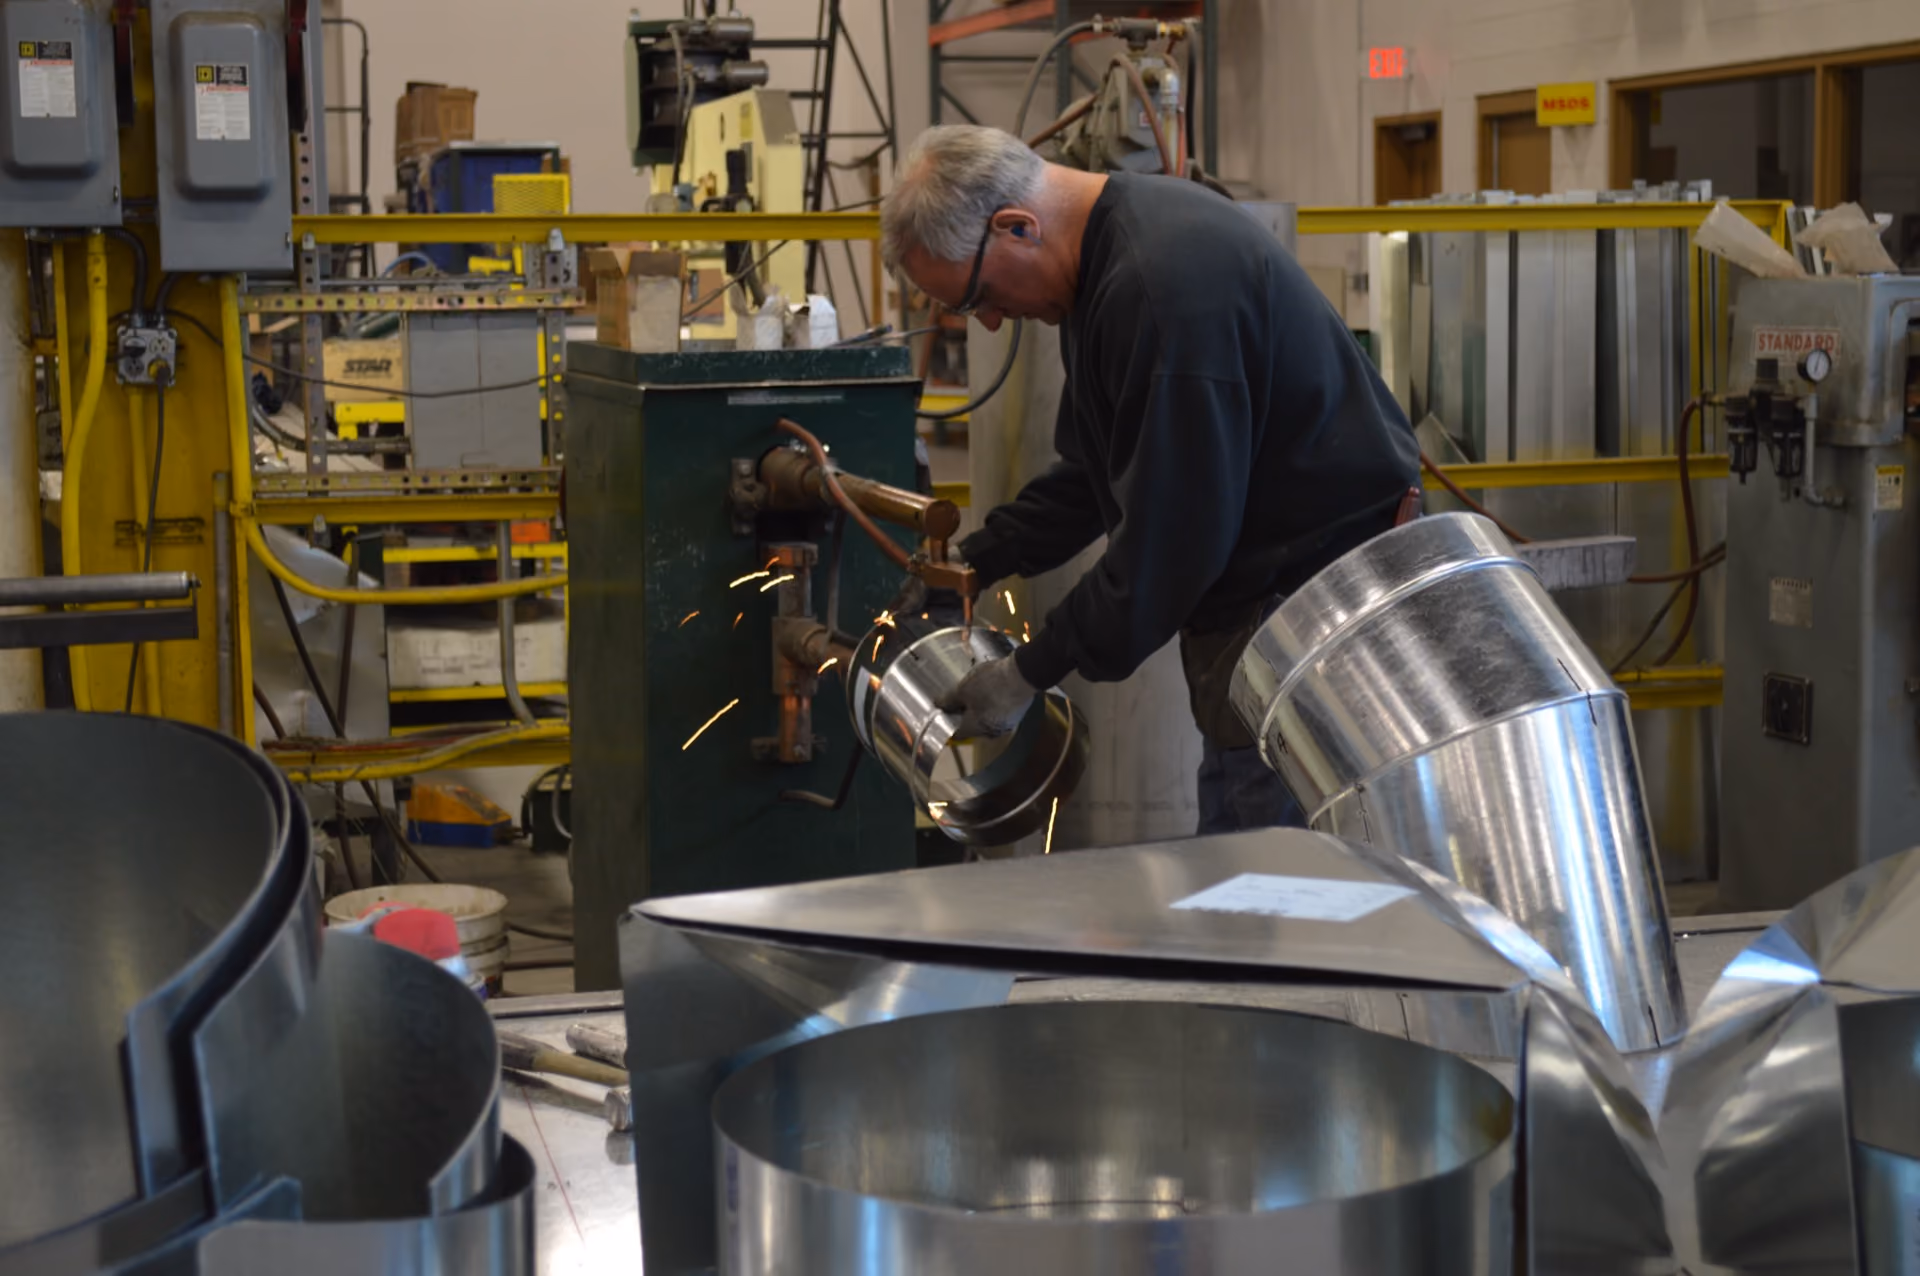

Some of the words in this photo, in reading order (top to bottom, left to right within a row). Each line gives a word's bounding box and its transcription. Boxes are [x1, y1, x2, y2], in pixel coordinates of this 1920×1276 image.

[1369, 47, 1403, 79] EXIT
[1543, 96, 1590, 112] MSDS
[1759, 332, 1834, 352] STANDARD
